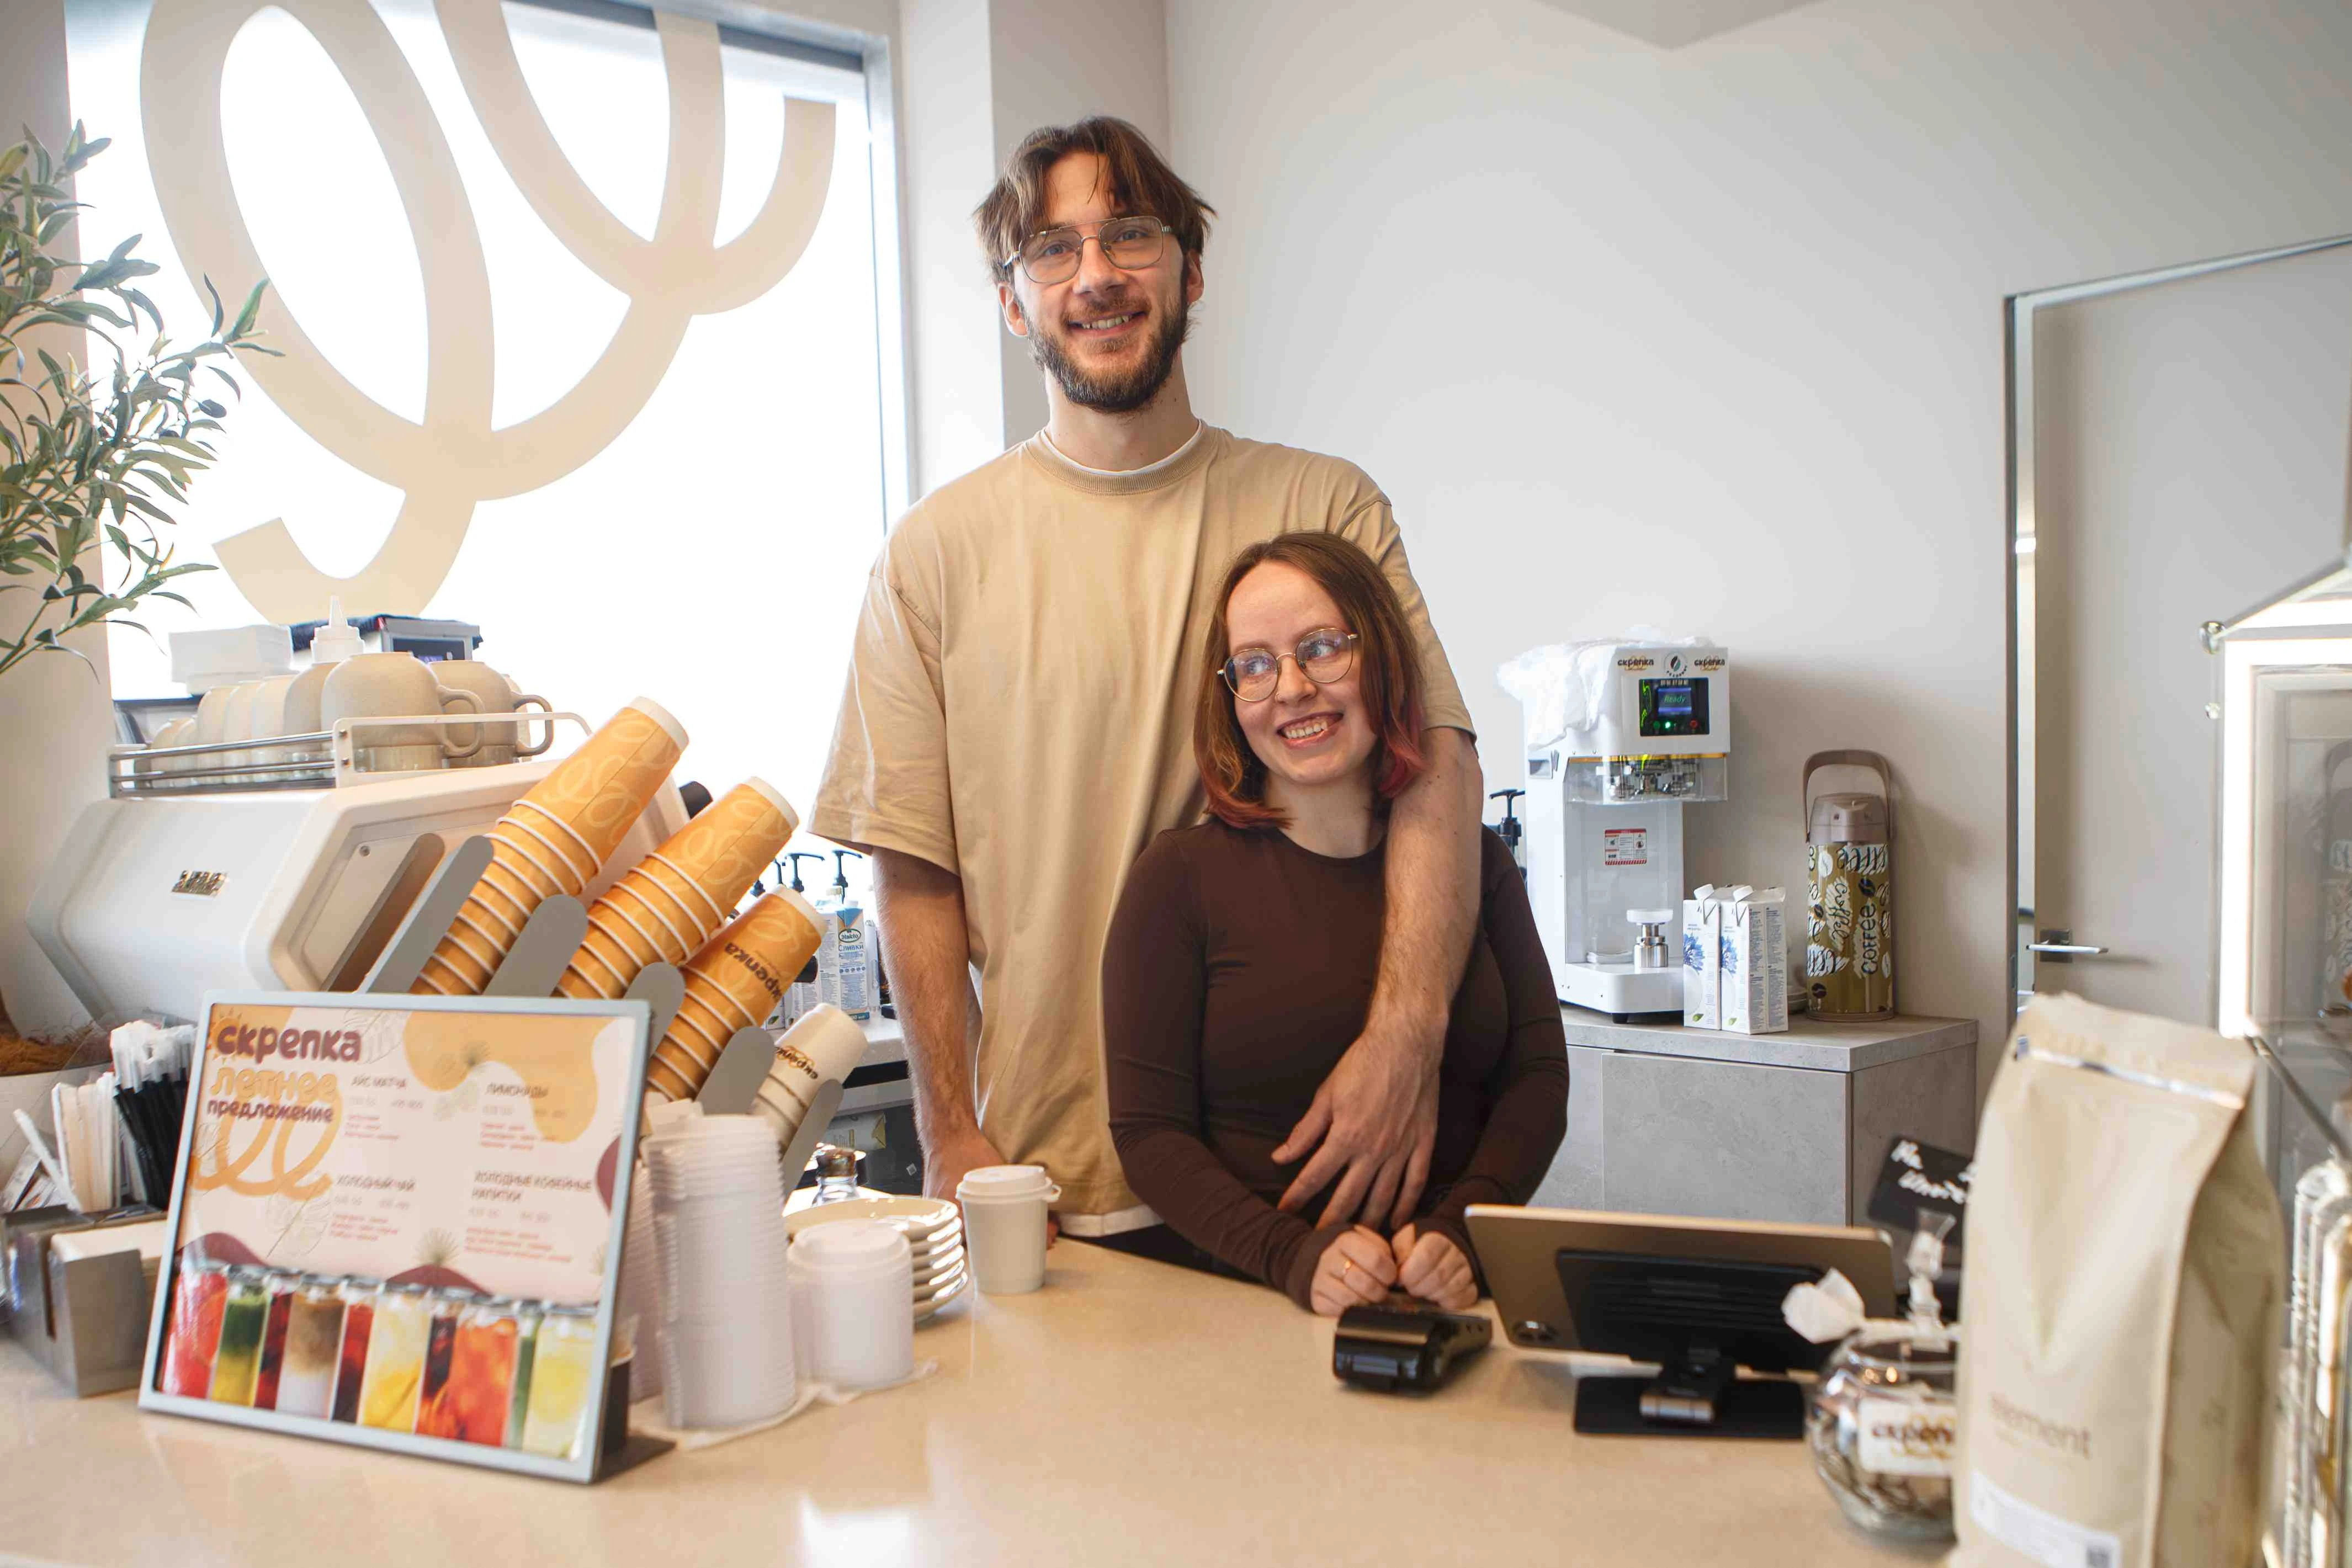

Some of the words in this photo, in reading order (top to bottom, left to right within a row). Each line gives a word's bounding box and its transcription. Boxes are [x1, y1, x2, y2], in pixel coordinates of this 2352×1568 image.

[1664, 694, 1686, 704] Ready
[217, 1025, 362, 1064] скрепка
[211, 1067, 337, 1102] летнее
[206, 1100, 333, 1123] предложение
